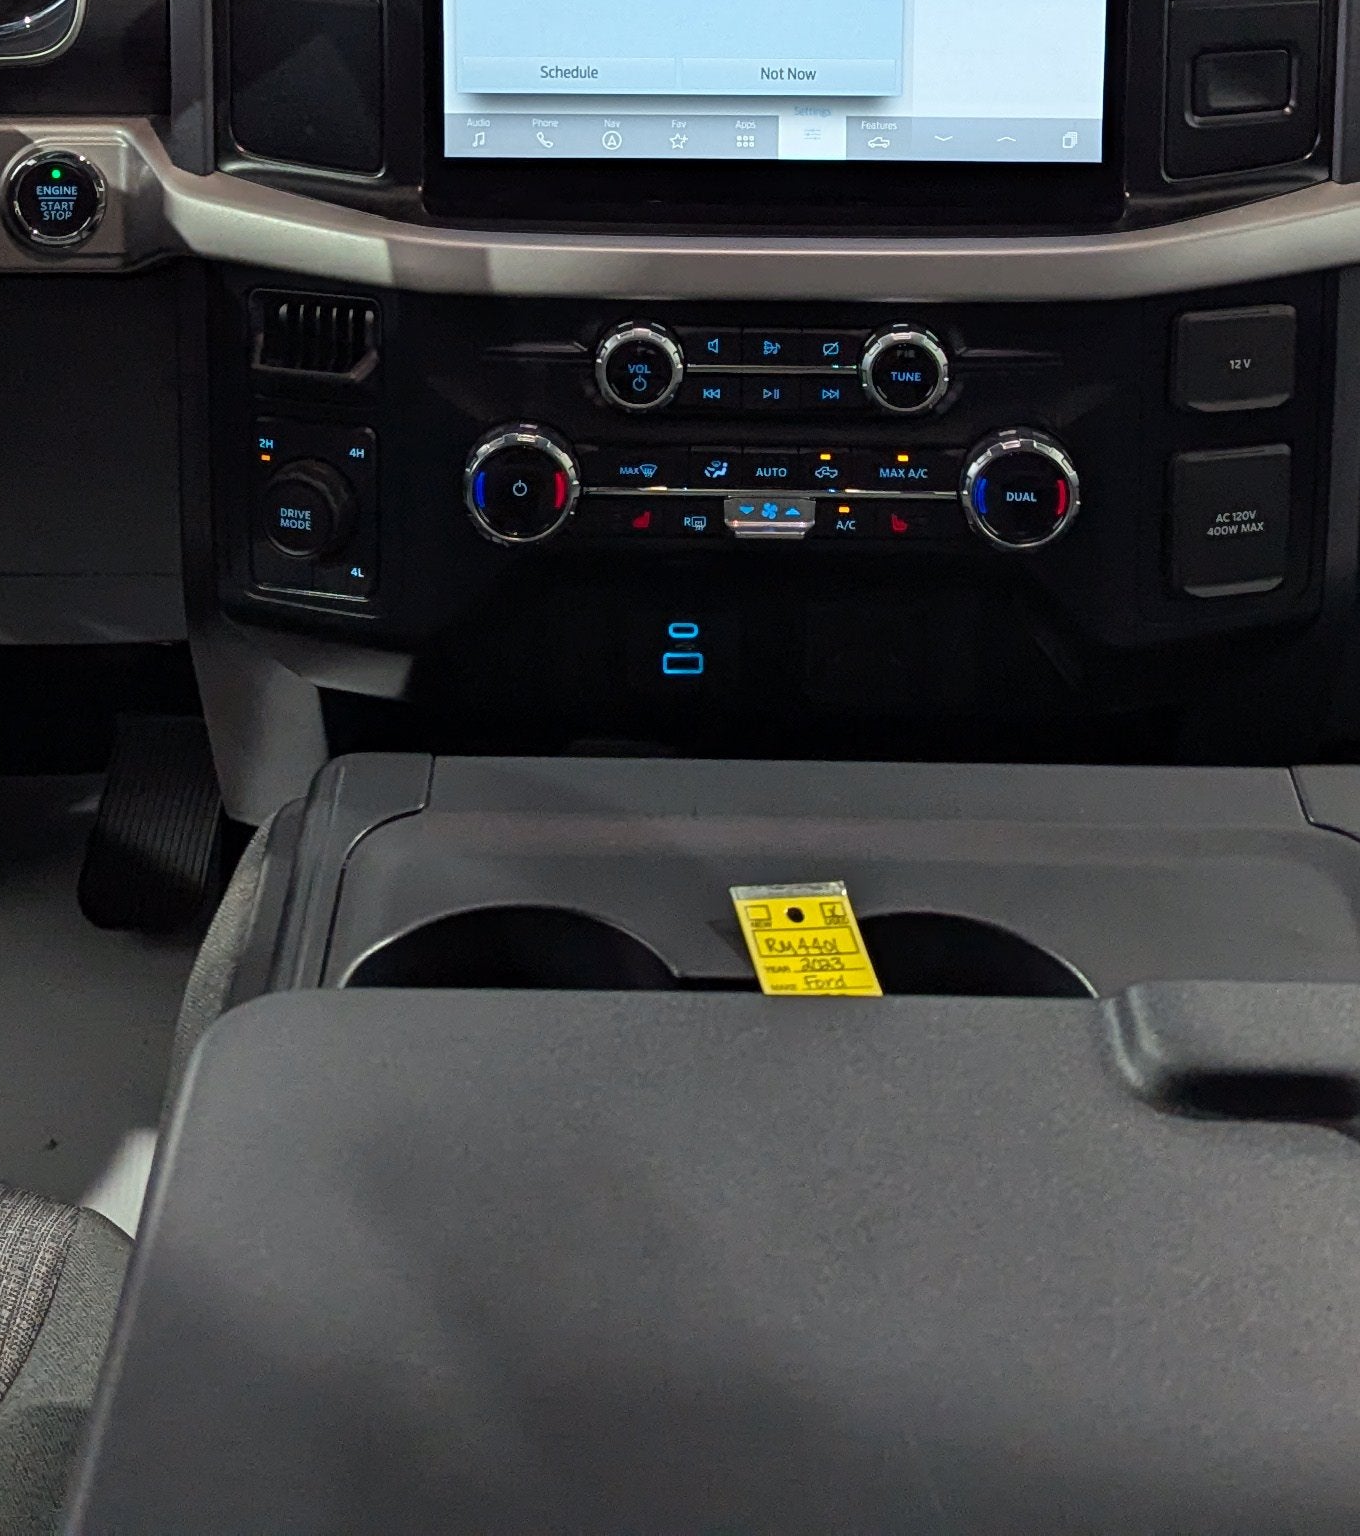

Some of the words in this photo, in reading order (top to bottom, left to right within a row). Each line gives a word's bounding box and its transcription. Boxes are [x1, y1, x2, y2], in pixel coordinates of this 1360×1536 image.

[540, 66, 598, 79] Schedule
[760, 67, 784, 80] Not
[787, 68, 817, 81] Now
[467, 118, 491, 128] Audio
[532, 118, 559, 128] Phone
[604, 119, 621, 129] Nav
[671, 119, 687, 129] Fav
[735, 120, 756, 131] Apps
[861, 121, 898, 131] Features
[36, 186, 78, 196] ENGINE
[40, 202, 75, 211] START
[42, 211, 73, 221] STOP
[628, 364, 651, 374] VOL
[1230, 360, 1241, 369] 12
[1243, 359, 1251, 368] V
[890, 371, 922, 382] TUNE
[259, 439, 274, 449] 2H
[349, 448, 365, 458] 4H
[619, 467, 639, 475] MAX
[755, 467, 787, 478] AUTO
[879, 468, 905, 478] MAX
[907, 468, 928, 479] A/C
[1006, 492, 1037, 503] DUAL
[280, 508, 311, 520] DRIVE
[1216, 513, 1230, 523] AC
[1232, 511, 1256, 522] 120V
[280, 519, 311, 530] MODE
[836, 520, 856, 531] A/C
[1206, 524, 1238, 536] 400W
[1241, 522, 1264, 533] MAX
[350, 568, 365, 578] 4L
[804, 975, 847, 990] Ford
